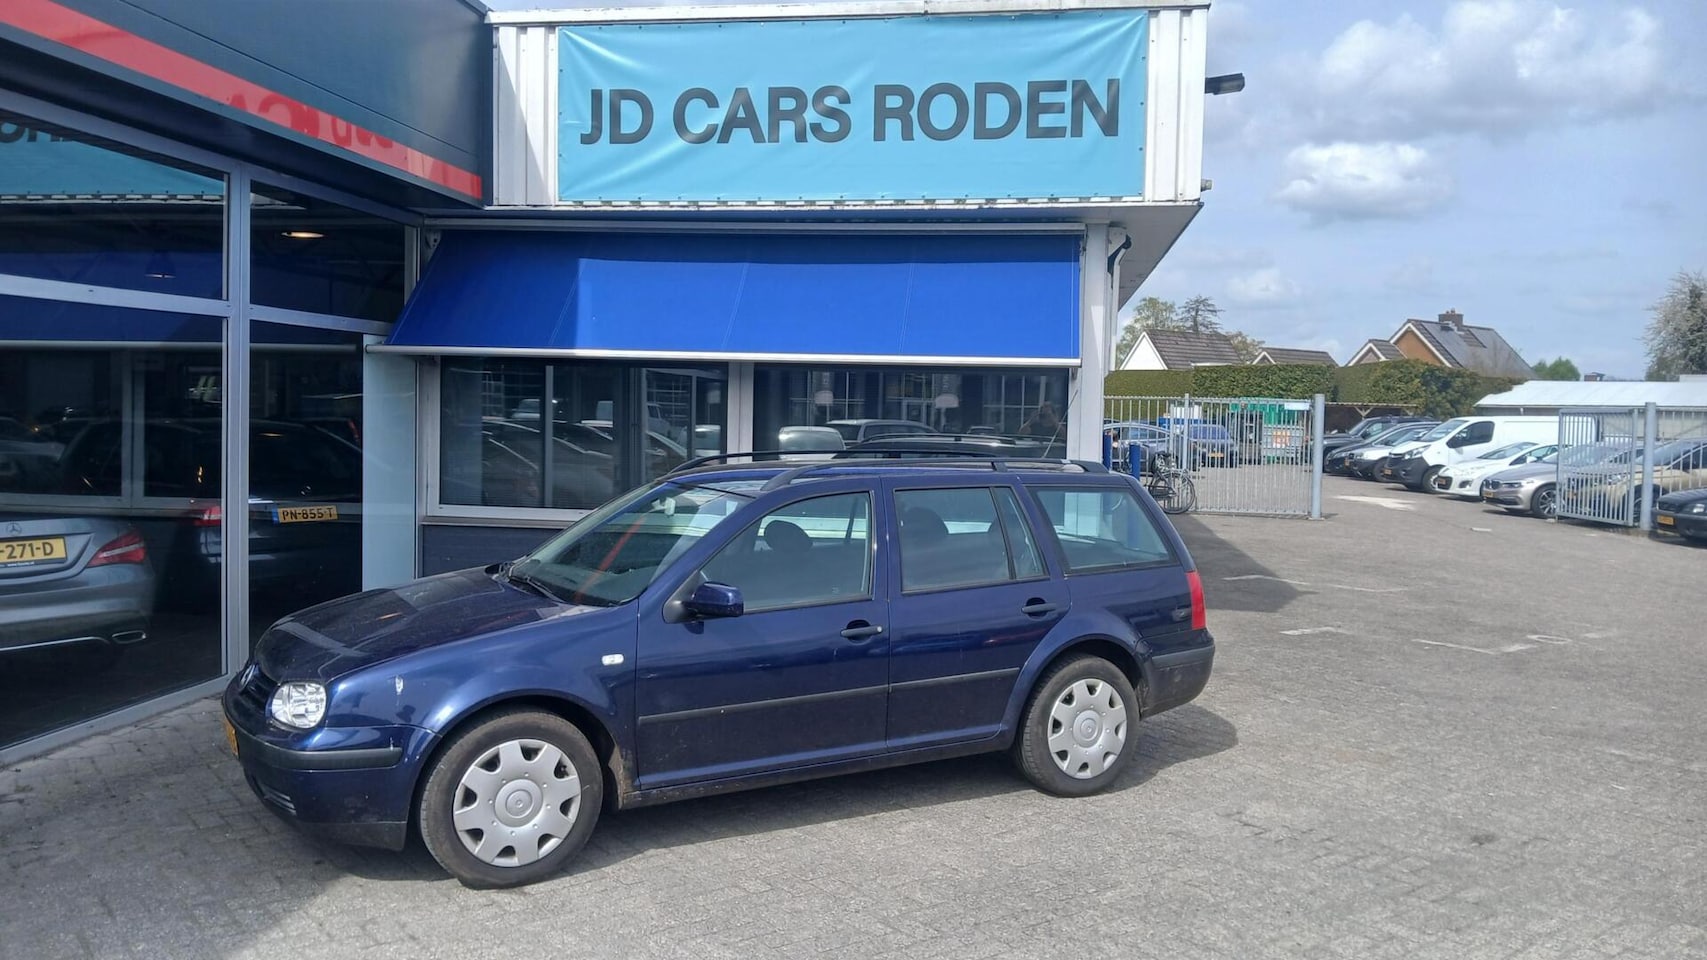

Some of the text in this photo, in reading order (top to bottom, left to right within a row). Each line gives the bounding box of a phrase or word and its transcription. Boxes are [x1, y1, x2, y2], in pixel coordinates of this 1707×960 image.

[580, 78, 1120, 145] JD CARS RODEN
[282, 507, 334, 521] PN-855-T
